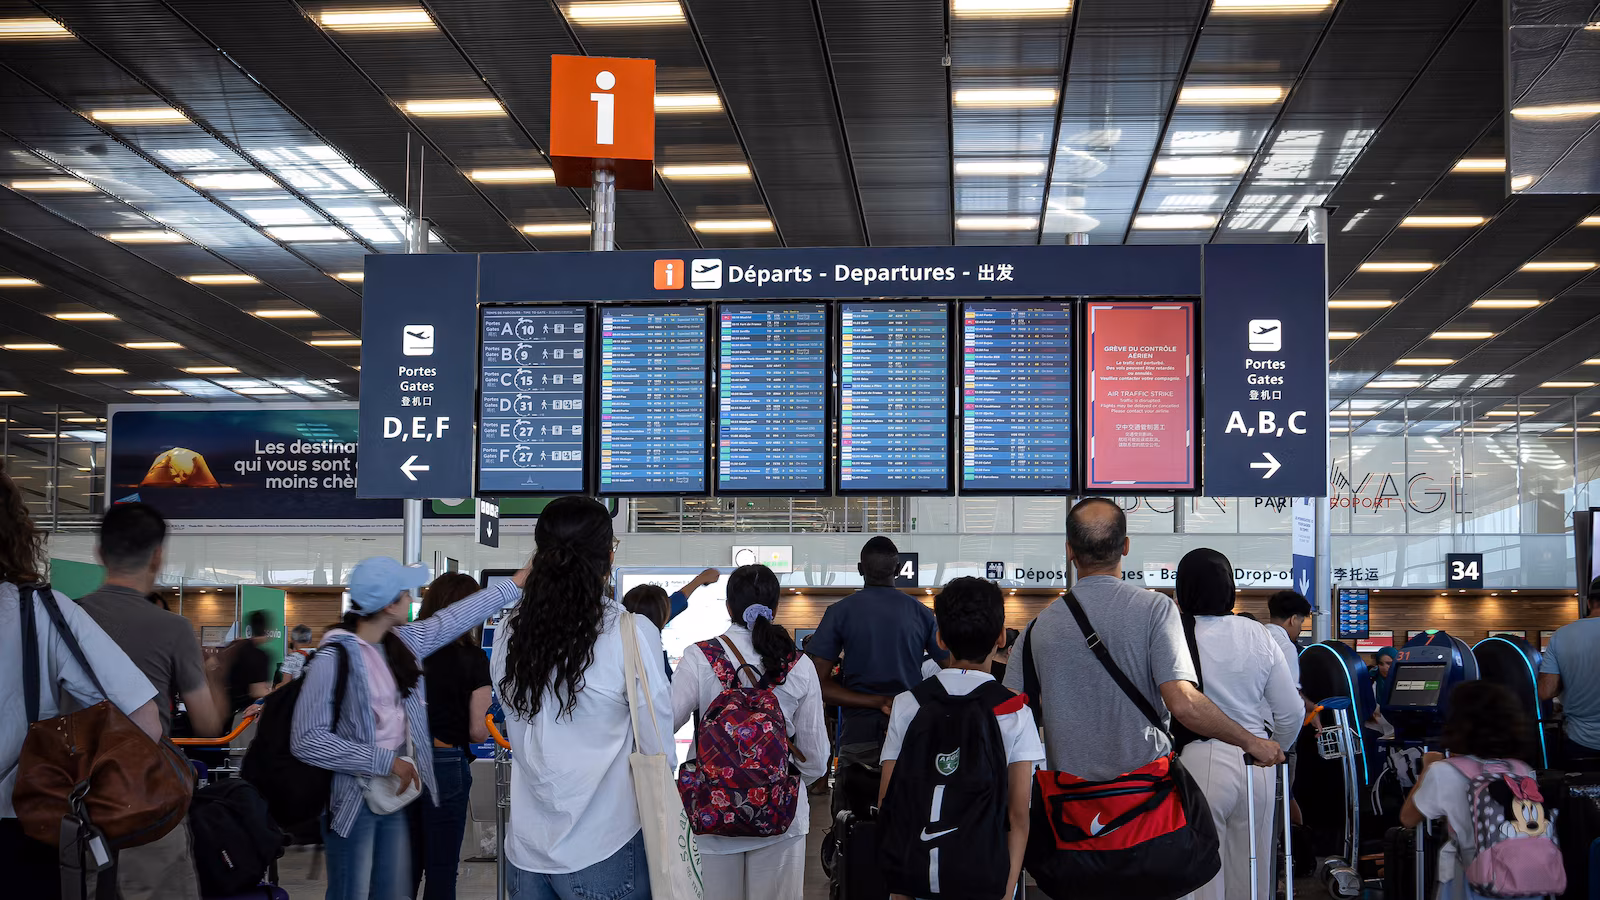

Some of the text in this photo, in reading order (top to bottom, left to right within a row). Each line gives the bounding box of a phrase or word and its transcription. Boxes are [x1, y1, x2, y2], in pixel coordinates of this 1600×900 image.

[728, 264, 812, 287] Départs
[834, 264, 956, 286] Departures
[978, 264, 1014, 282] 出发
[501, 322, 513, 336] A
[521, 325, 534, 335] 10
[502, 348, 512, 360] B
[521, 351, 528, 360] 9
[1245, 358, 1286, 370] Portes
[398, 366, 437, 377] Portes
[501, 373, 512, 386] C
[520, 376, 533, 386] 15
[1247, 374, 1284, 385] Gates
[400, 381, 434, 391] Gates
[401, 396, 432, 406] 登机口
[1249, 390, 1282, 400] 登机口
[500, 398, 511, 412] D
[520, 402, 532, 411] 31
[383, 416, 450, 442] D,E,F
[1224, 410, 1307, 437] A,B,C
[501, 424, 510, 437] E
[520, 427, 534, 436] 27
[256, 439, 358, 454] Les destina
[500, 449, 510, 462] F
[519, 453, 533, 462] 27
[234, 457, 261, 475] qui
[266, 460, 307, 471] vous
[312, 458, 351, 471] sont
[265, 474, 318, 488] moins
[1255, 497, 1393, 508] PARI ROPORT
[895, 560, 914, 579] 4
[1235, 567, 1293, 583] Drop-of
[1331, 568, 1378, 581] 李托运
[1451, 561, 1479, 581] 34
[1425, 635, 1435, 646] 7
[1397, 652, 1410, 660] 31
